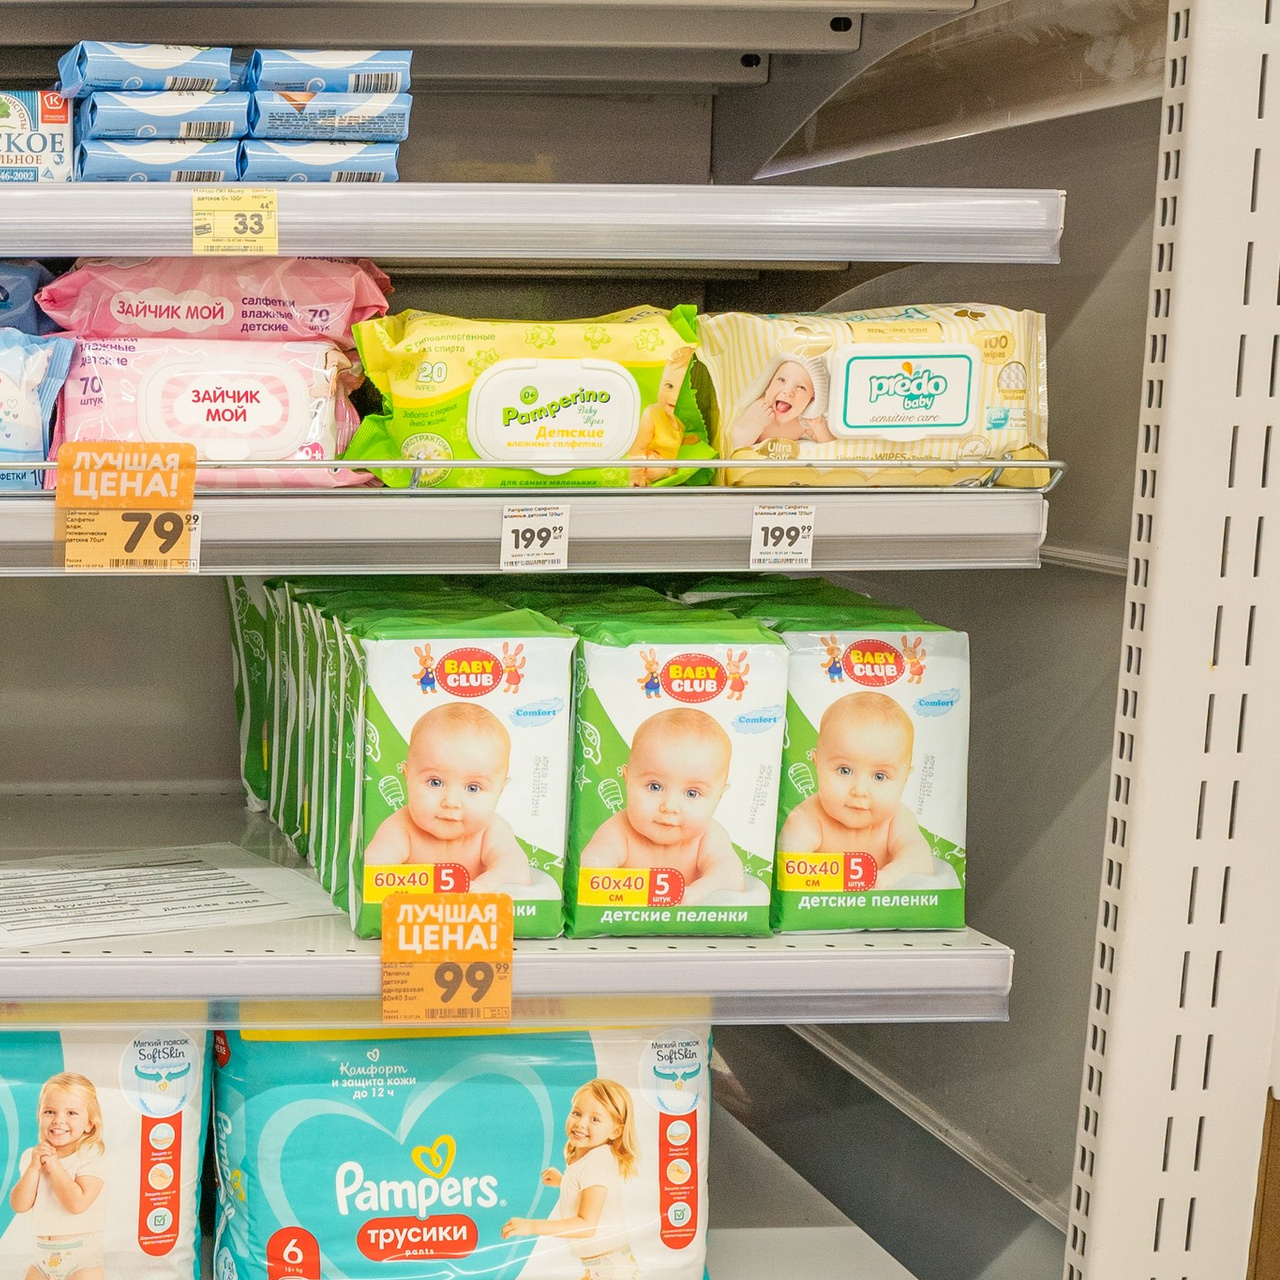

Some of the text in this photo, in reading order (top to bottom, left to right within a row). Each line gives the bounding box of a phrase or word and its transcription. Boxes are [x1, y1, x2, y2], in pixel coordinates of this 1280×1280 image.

[234, 214, 263, 234] 33
[309, 310, 330, 322] 70
[241, 323, 288, 333] детские
[417, 362, 448, 383] 20
[192, 387, 259, 403] ЗАЙЧИК
[869, 371, 948, 404] predo
[503, 388, 610, 426] Pamperino
[903, 394, 934, 409] baby
[206, 407, 246, 422] МОЙ
[870, 414, 940, 423] sensitive care
[536, 426, 604, 439] Детские
[73, 452, 180, 470] ЛУЧШАЯ
[73, 472, 177, 499] ЦЕНА!
[121, 512, 184, 555] 79
[511, 529, 551, 549] 199
[669, 664, 720, 679] BABY
[671, 678, 717, 693] CLUB
[739, 715, 778, 724] Comfort
[601, 908, 748, 923] детские пеленки
[434, 962, 493, 1001] 99
